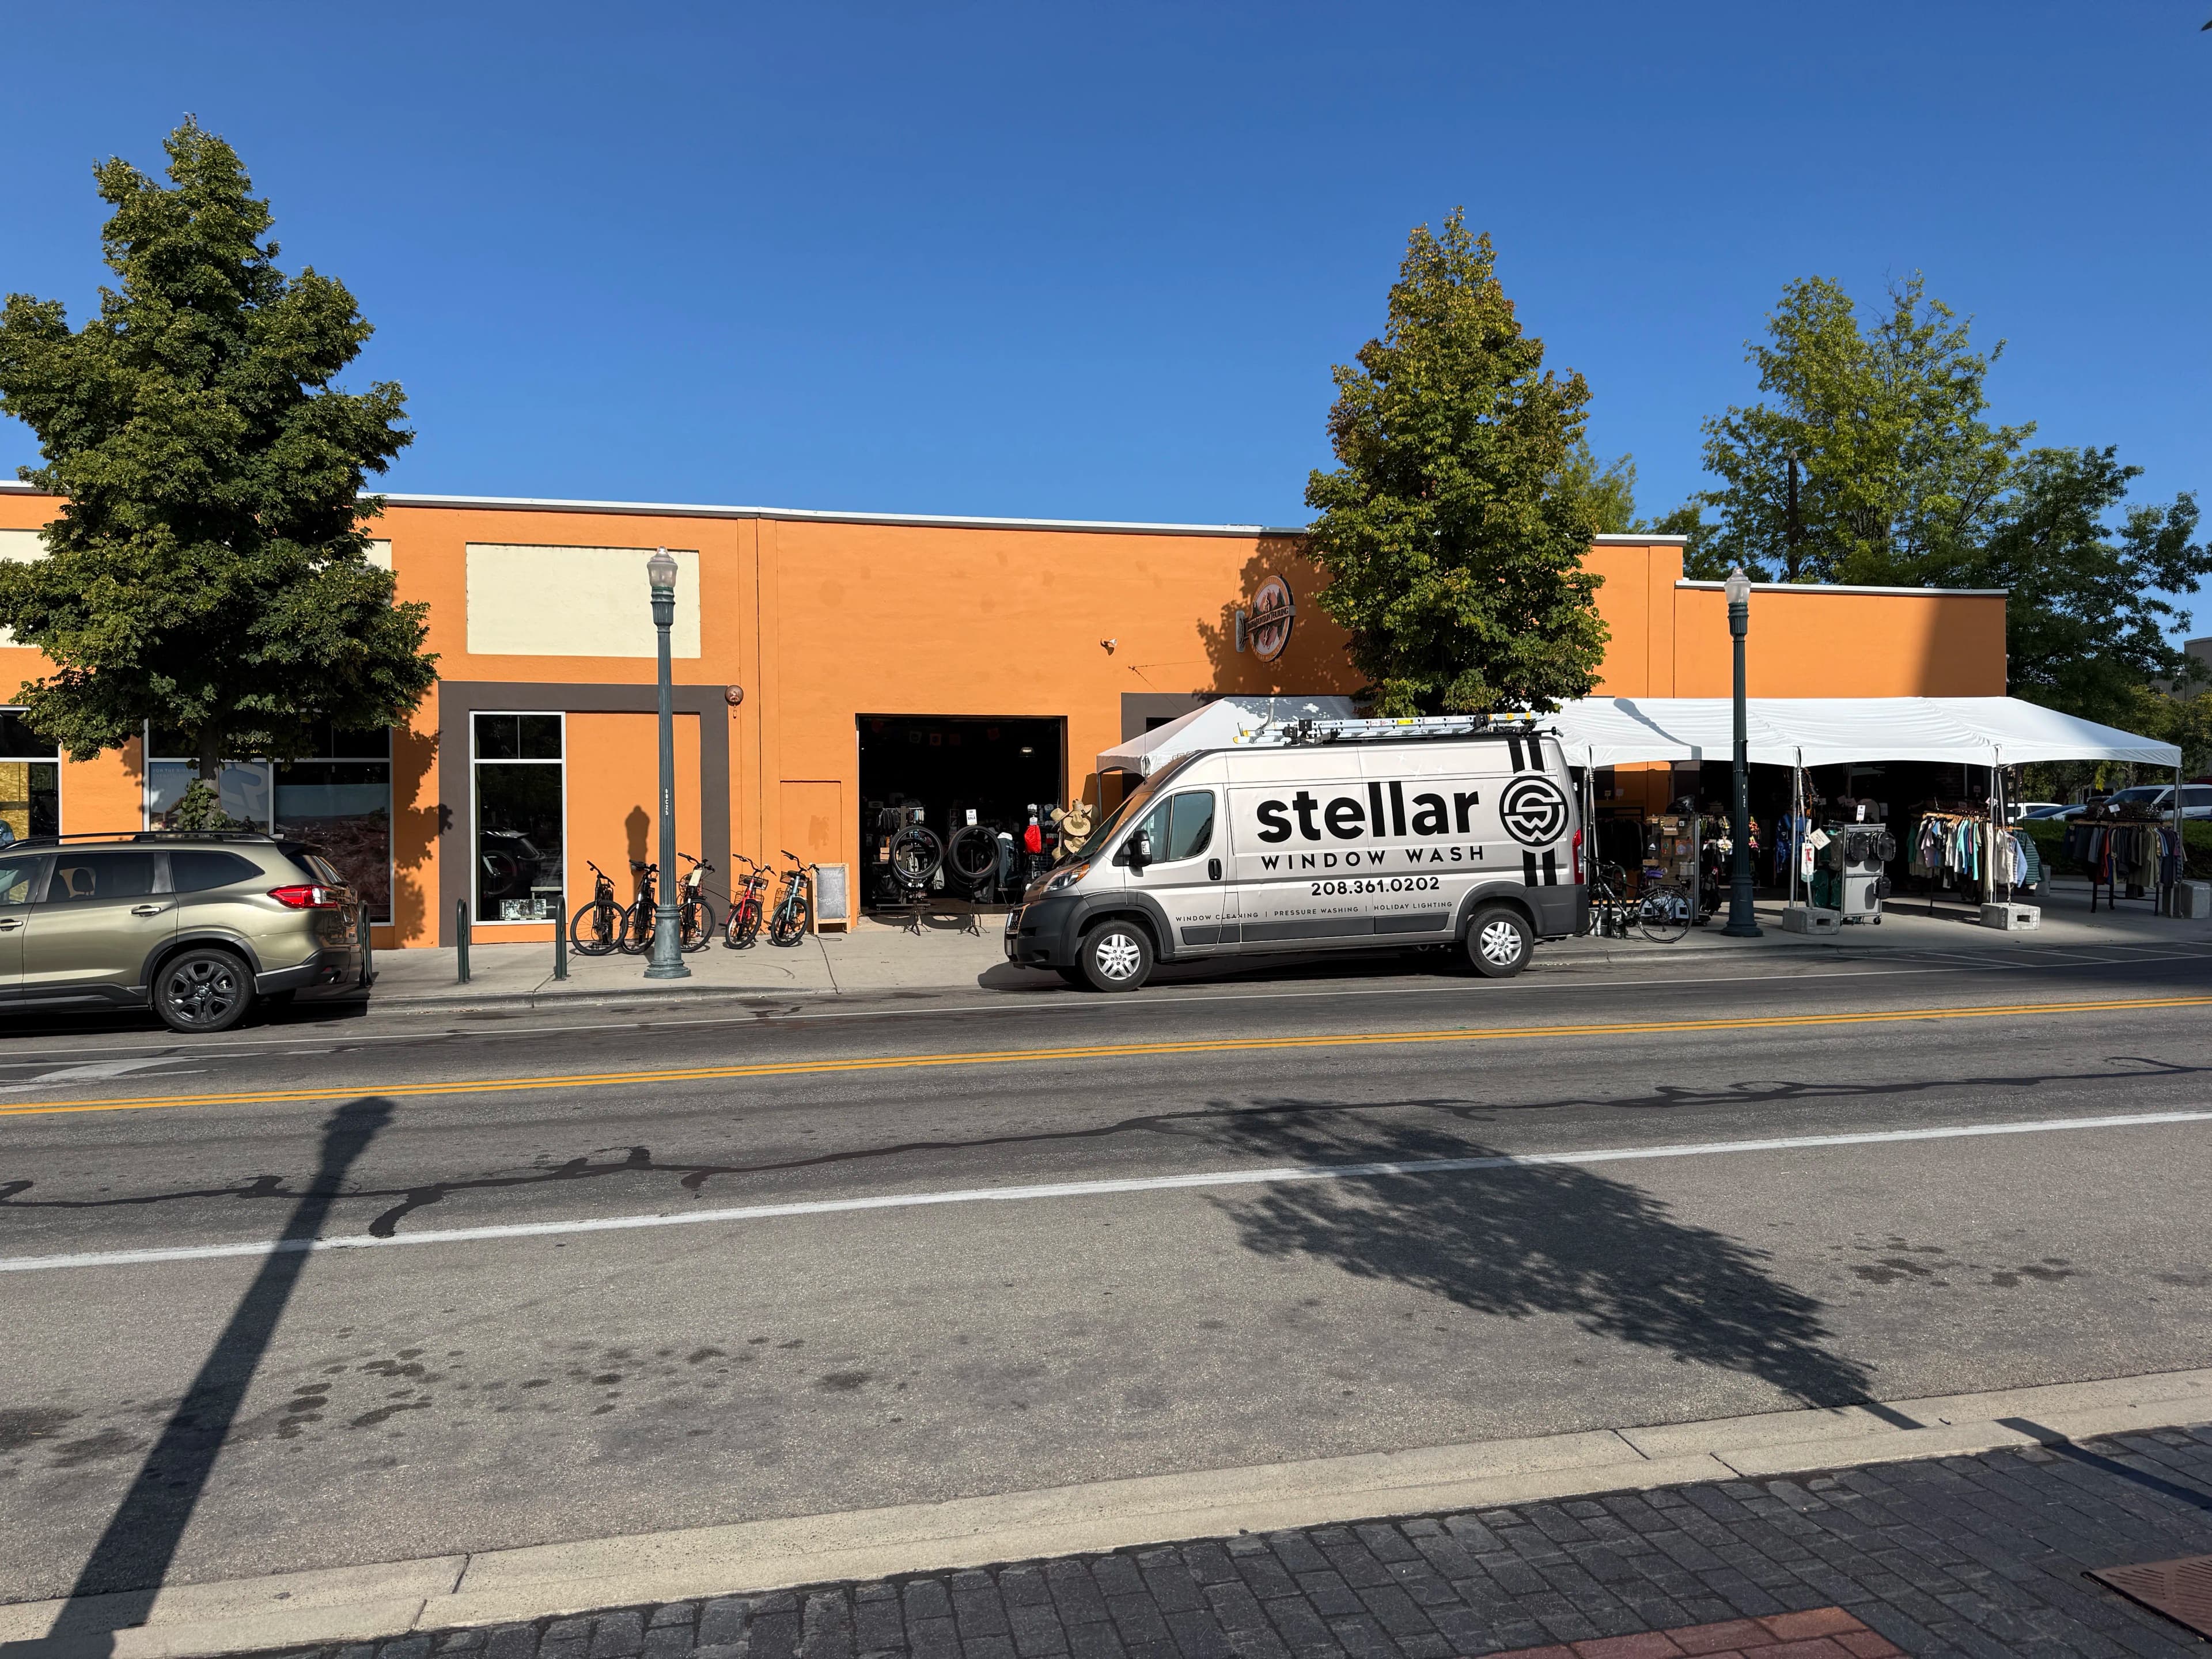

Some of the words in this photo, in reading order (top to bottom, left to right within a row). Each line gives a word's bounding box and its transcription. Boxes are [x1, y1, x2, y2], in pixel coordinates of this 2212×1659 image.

[1256, 781, 1480, 843] stellar
[1261, 850, 1385, 871] WINDOW
[1405, 845, 1483, 864] WASH
[1311, 876, 1440, 896] 208.361.0202
[1215, 912, 1259, 920] CLEANING
[1274, 908, 1317, 916] PRESSURE
